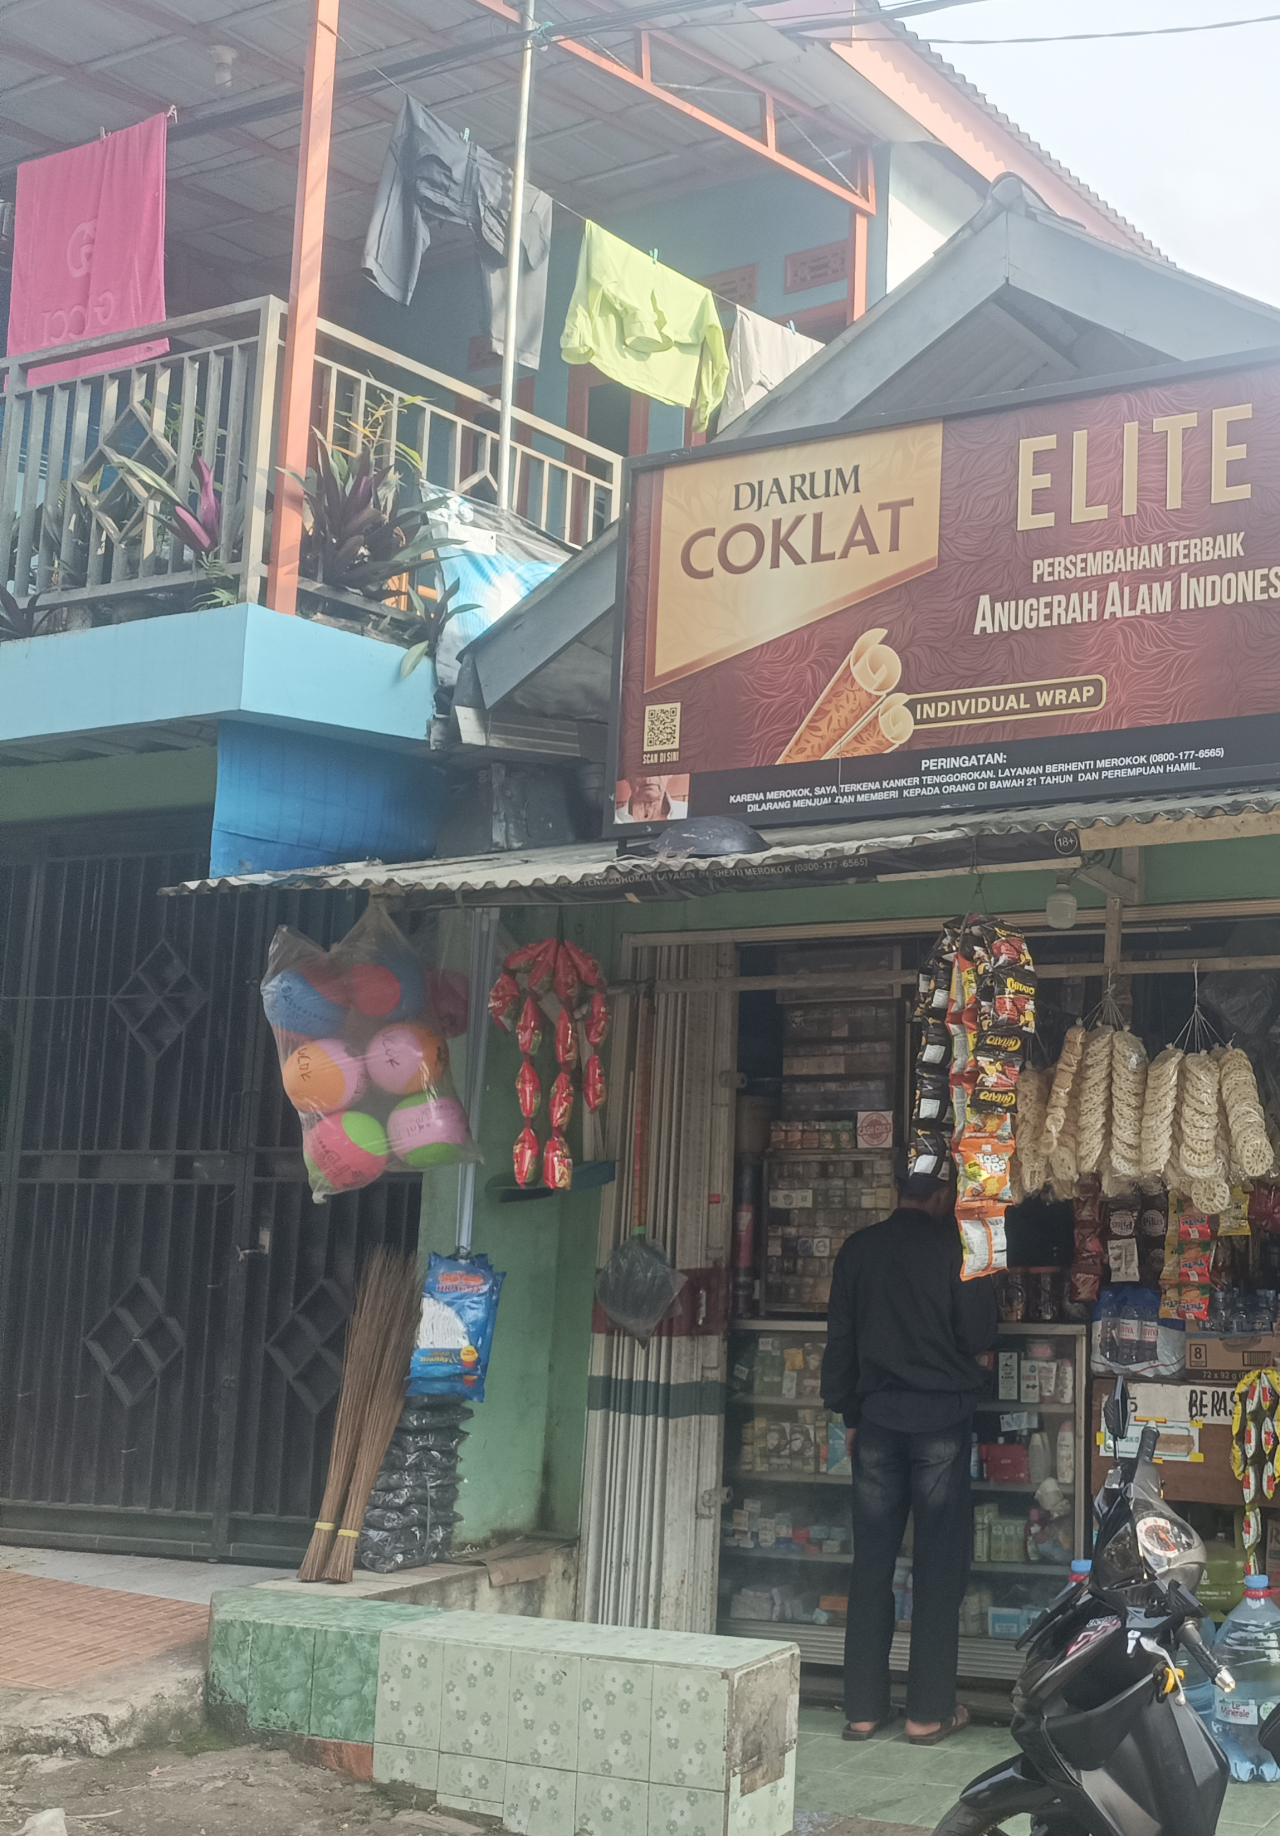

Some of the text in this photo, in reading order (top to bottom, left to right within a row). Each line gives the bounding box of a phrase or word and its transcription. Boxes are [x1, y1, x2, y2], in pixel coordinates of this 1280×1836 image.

[1016, 402, 1253, 532] ELITE
[733, 464, 861, 512] DJARUM
[680, 497, 914, 580] COKLAT
[1032, 532, 1245, 583] PERSEMBAHAN TERBAIK
[973, 589, 1098, 635] ANUGERAH
[1103, 581, 1172, 620] ALAM
[916, 686, 1095, 720] INDIVIDUAL WRAP
[642, 751, 679, 765] SCAN DI SINI
[921, 752, 1007, 771] PERINGATAN:
[729, 747, 1225, 804] KARENA MEROKOK, SAYA TERKENA KANKER TENGGOROKAN. LAYANAN BERHENTI MEROKOK (0800-177-6565)
[747, 800, 791, 813] DILARANG
[856, 790, 898, 803] MEMBERI
[903, 785, 940, 798] KEPADA
[942, 782, 976, 794] ORANG
[978, 780, 987, 791] DI
[989, 778, 1025, 790] BAWAH
[1026, 776, 1037, 787] 21
[1039, 773, 1073, 785] TAHUN
[1078, 771, 1099, 782] DAN
[1101, 765, 1164, 780] PEREMPUAN
[1166, 761, 1201, 774] HAMIL.
[1056, 836, 1075, 848] 18+
[745, 864, 792, 876] MEROKOK
[1007, 977, 1036, 995] CHITATO
[985, 1034, 1022, 1051] CHITATO
[979, 1090, 1016, 1107] CHITATO
[975, 1153, 999, 1164] TOS
[984, 1159, 1006, 1173] TOS
[1194, 1346, 1203, 1360] 8
[1202, 1371, 1212, 1379] 72
[1220, 1371, 1231, 1380] 92
[1220, 1704, 1250, 1719] Minerale
[1232, 1700, 1241, 1710] Le
